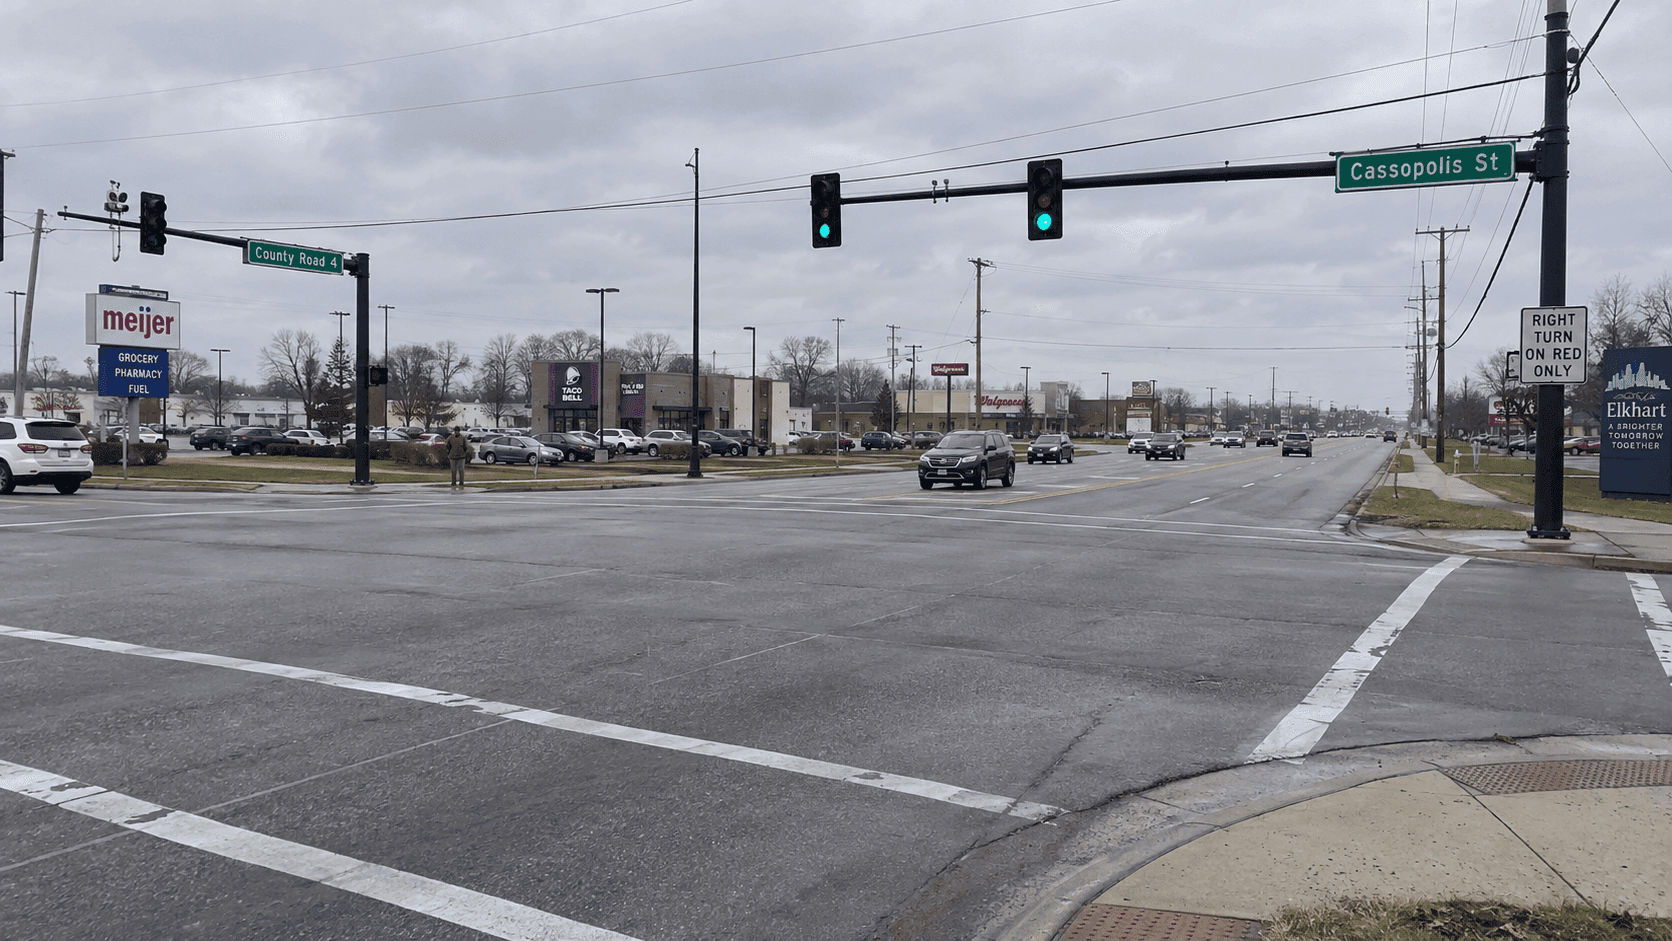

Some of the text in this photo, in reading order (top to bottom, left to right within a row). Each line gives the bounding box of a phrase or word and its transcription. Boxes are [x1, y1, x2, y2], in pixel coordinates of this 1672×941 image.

[1350, 152, 1499, 181] Cassopolis St
[255, 246, 338, 269] County Road 4
[103, 306, 175, 339] meijer
[1532, 313, 1576, 327] RIGHT
[1534, 331, 1573, 343] TURN
[118, 352, 159, 364] GROCERY
[1525, 347, 1582, 360] ON RED
[114, 367, 162, 379] PHARMACY
[1534, 364, 1573, 377] ONLY
[128, 384, 150, 395] FUEL
[562, 394, 583, 402] BELL
[1607, 401, 1667, 418] Elkhart
